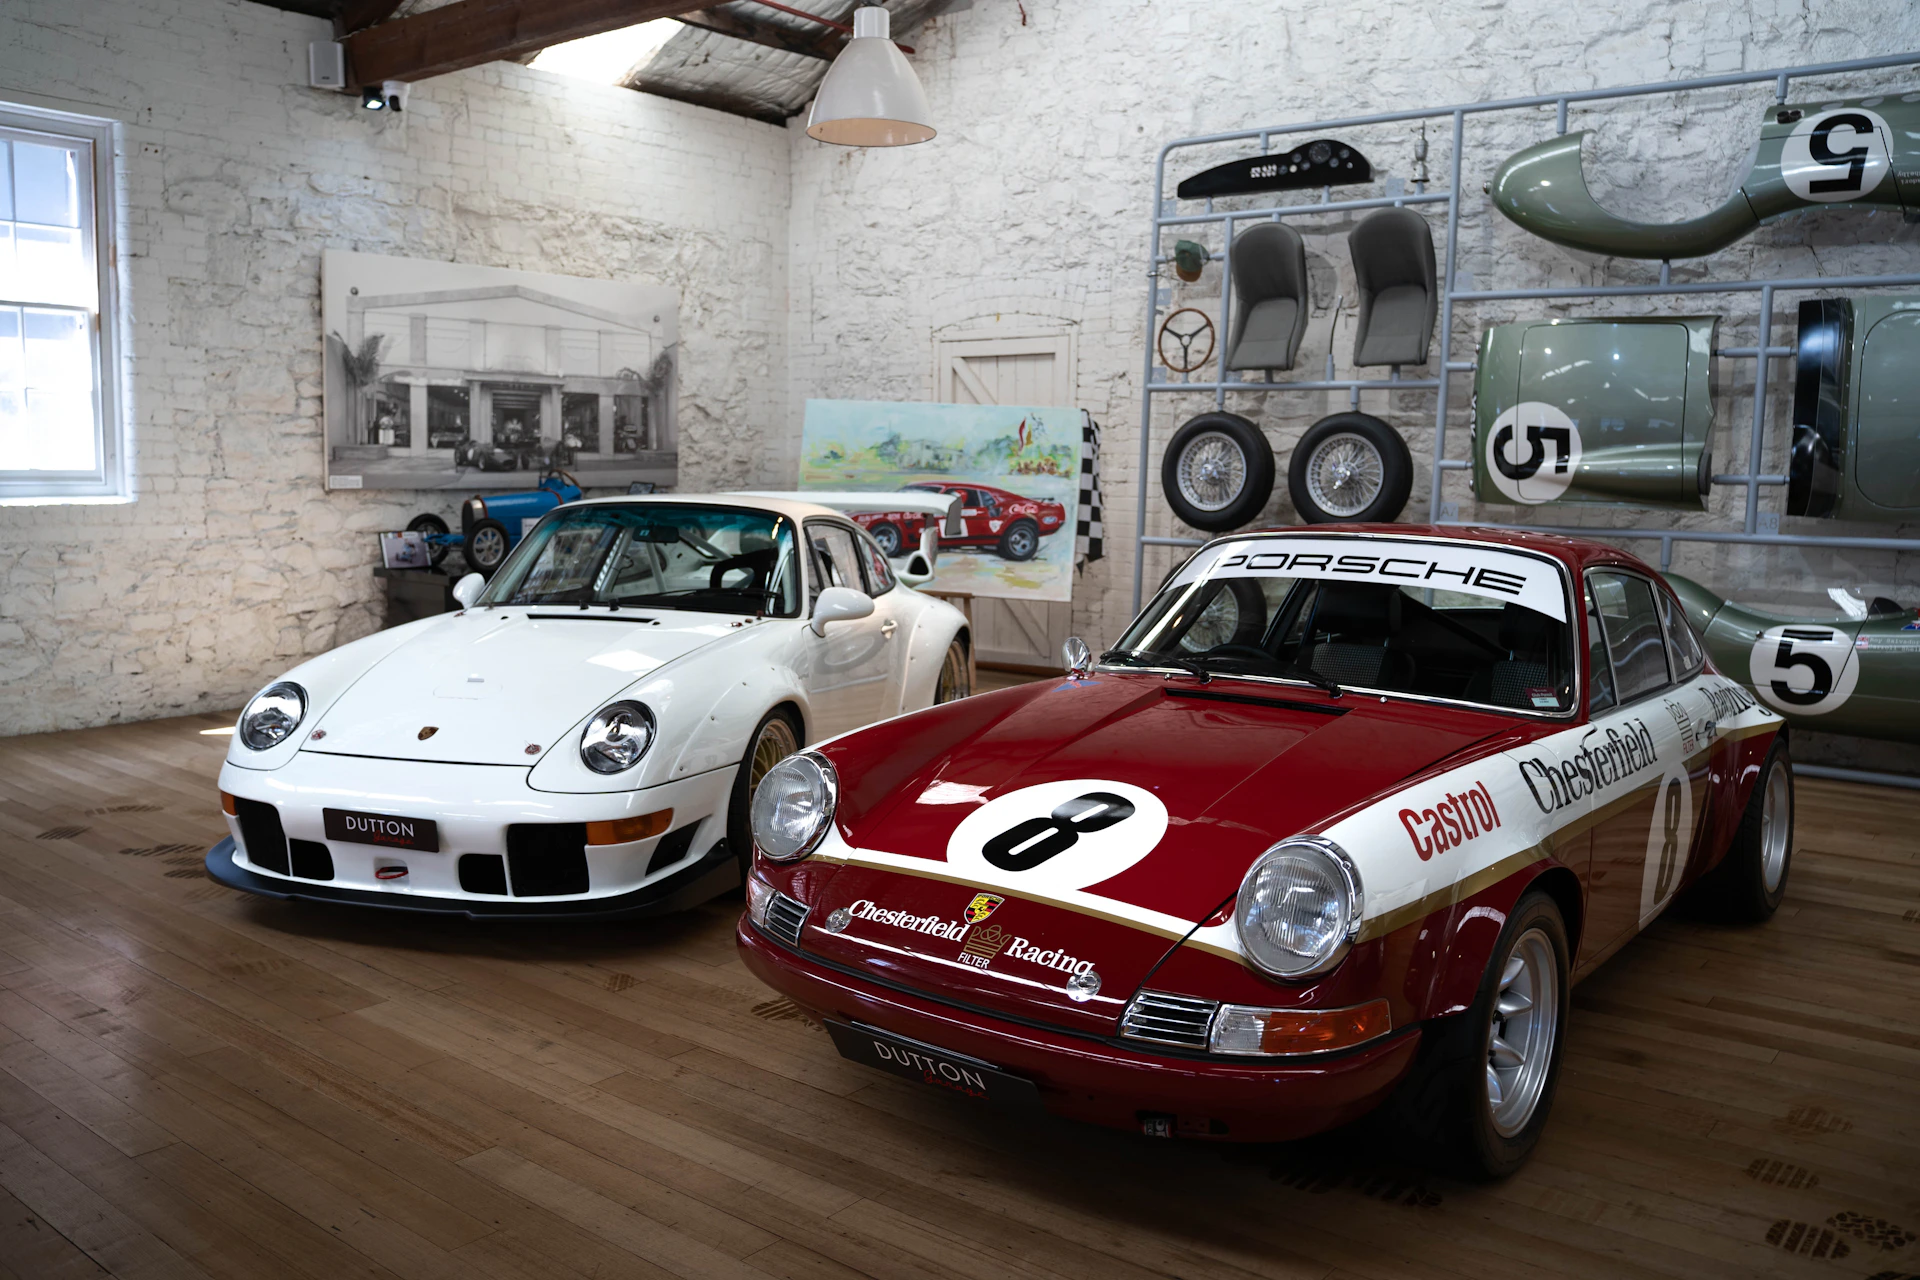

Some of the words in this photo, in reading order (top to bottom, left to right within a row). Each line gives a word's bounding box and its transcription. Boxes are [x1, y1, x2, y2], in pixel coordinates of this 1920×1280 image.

[1809, 113, 1874, 194] 5
[1493, 424, 1571, 482] 5
[1218, 553, 1527, 596] PORSCHE
[1771, 628, 1834, 706] 5
[1519, 717, 1658, 814] Chesterfield
[345, 816, 415, 837] DUTTON
[982, 791, 1136, 872] 8
[1398, 780, 1502, 863] Castrol
[1654, 777, 1682, 905] 8
[848, 899, 970, 943] Chesterfield
[957, 951, 991, 969] FILTER
[873, 1041, 987, 1091] DUTTON
